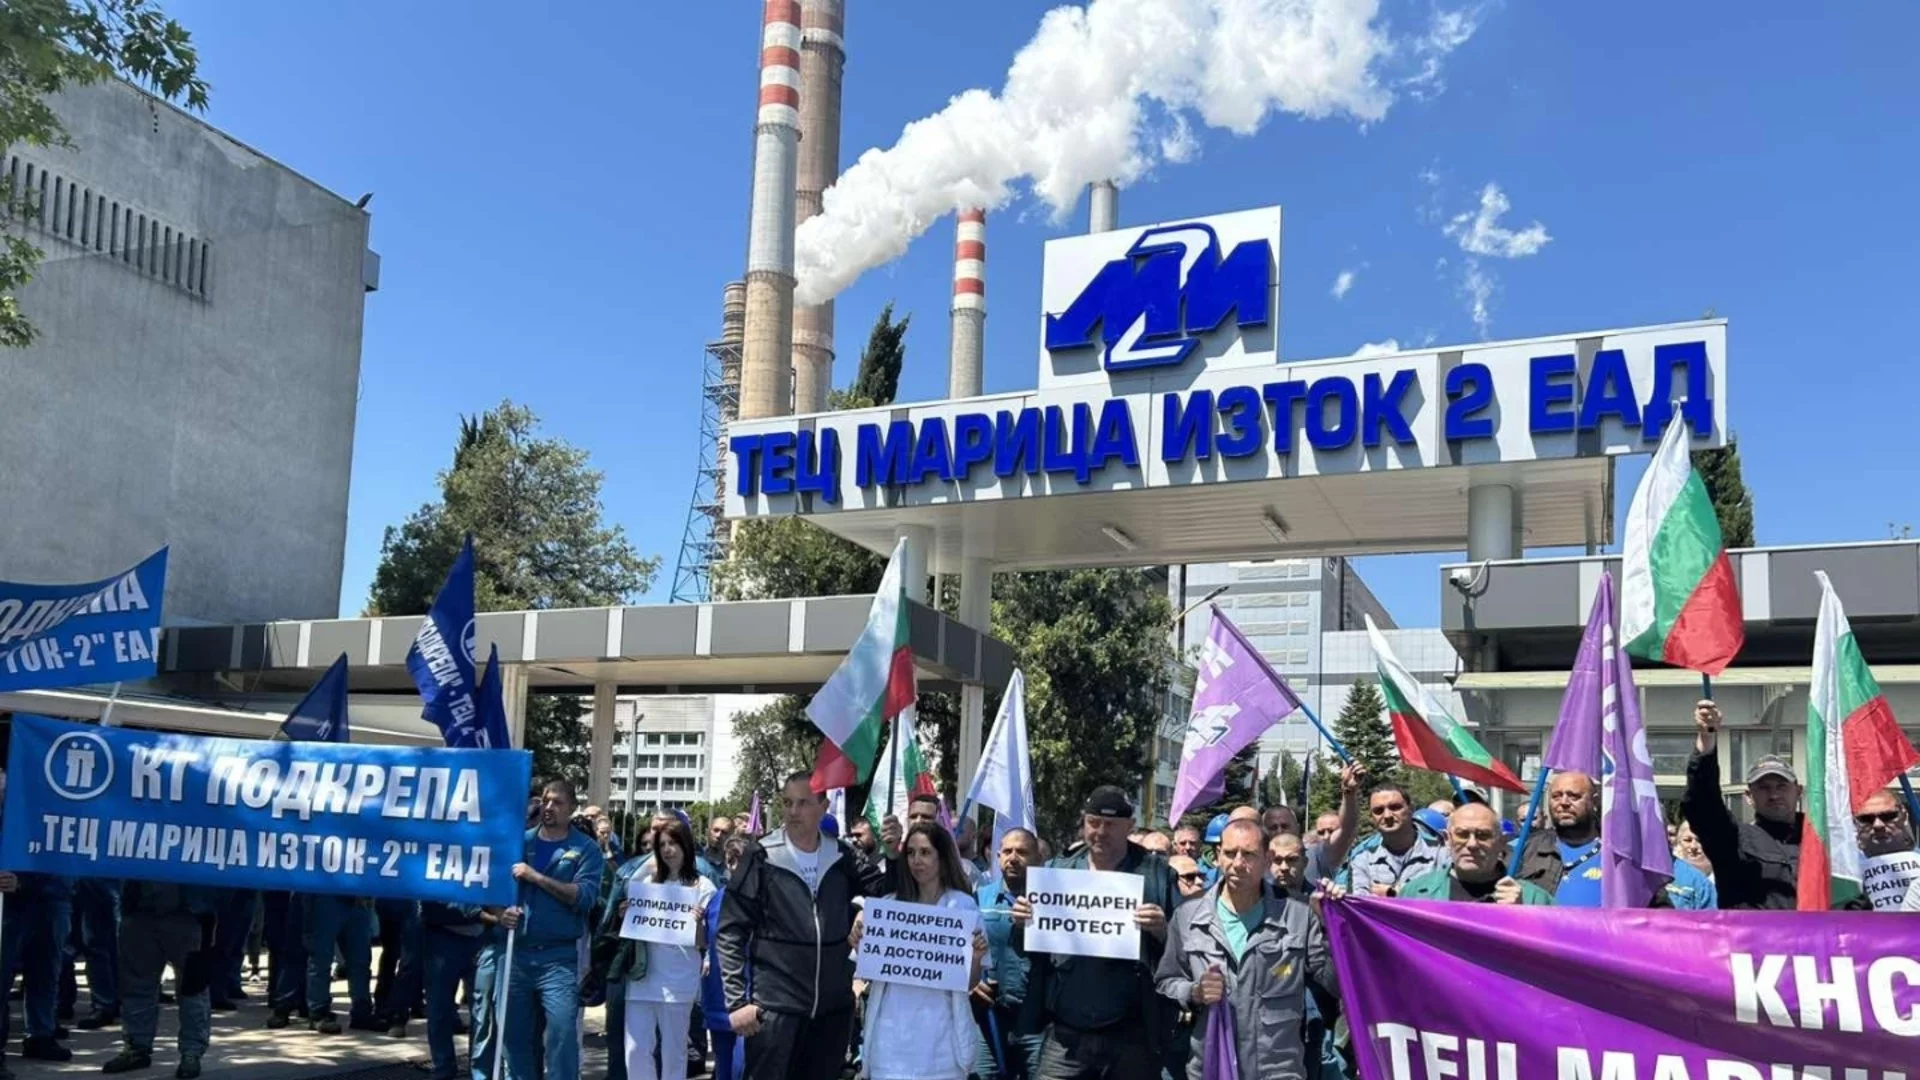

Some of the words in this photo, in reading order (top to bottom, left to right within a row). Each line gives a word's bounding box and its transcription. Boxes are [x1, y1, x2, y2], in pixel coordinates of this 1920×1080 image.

[730, 427, 839, 504] ТЕЦ
[855, 399, 1140, 488] МАРИЦА
[1162, 368, 1417, 464] ИЗТОК
[1445, 363, 1493, 441] 2
[1530, 340, 1712, 442] ЕАД
[130, 746, 198, 801] КТ
[206, 756, 481, 823] ПОДКРЕПА
[107, 820, 248, 870] МАРИЦА
[425, 843, 490, 888] ЕАД
[1863, 876, 1918, 895] СКАНЕ
[1028, 891, 1138, 910] СОЛИДАРЕН
[632, 915, 686, 930] ПРОТЕСТ
[873, 909, 882, 919] В
[886, 910, 963, 930] ПОДКРЕПА
[1038, 917, 1126, 935] ПРОТЕСТ
[866, 925, 885, 938] НА
[890, 928, 967, 947] ИСКАНЕТО
[863, 943, 881, 954] ЗА
[884, 945, 965, 965] ДОСТОЙНИ
[880, 963, 943, 980] ДОХОДИ
[1730, 952, 1920, 1037] КНС
